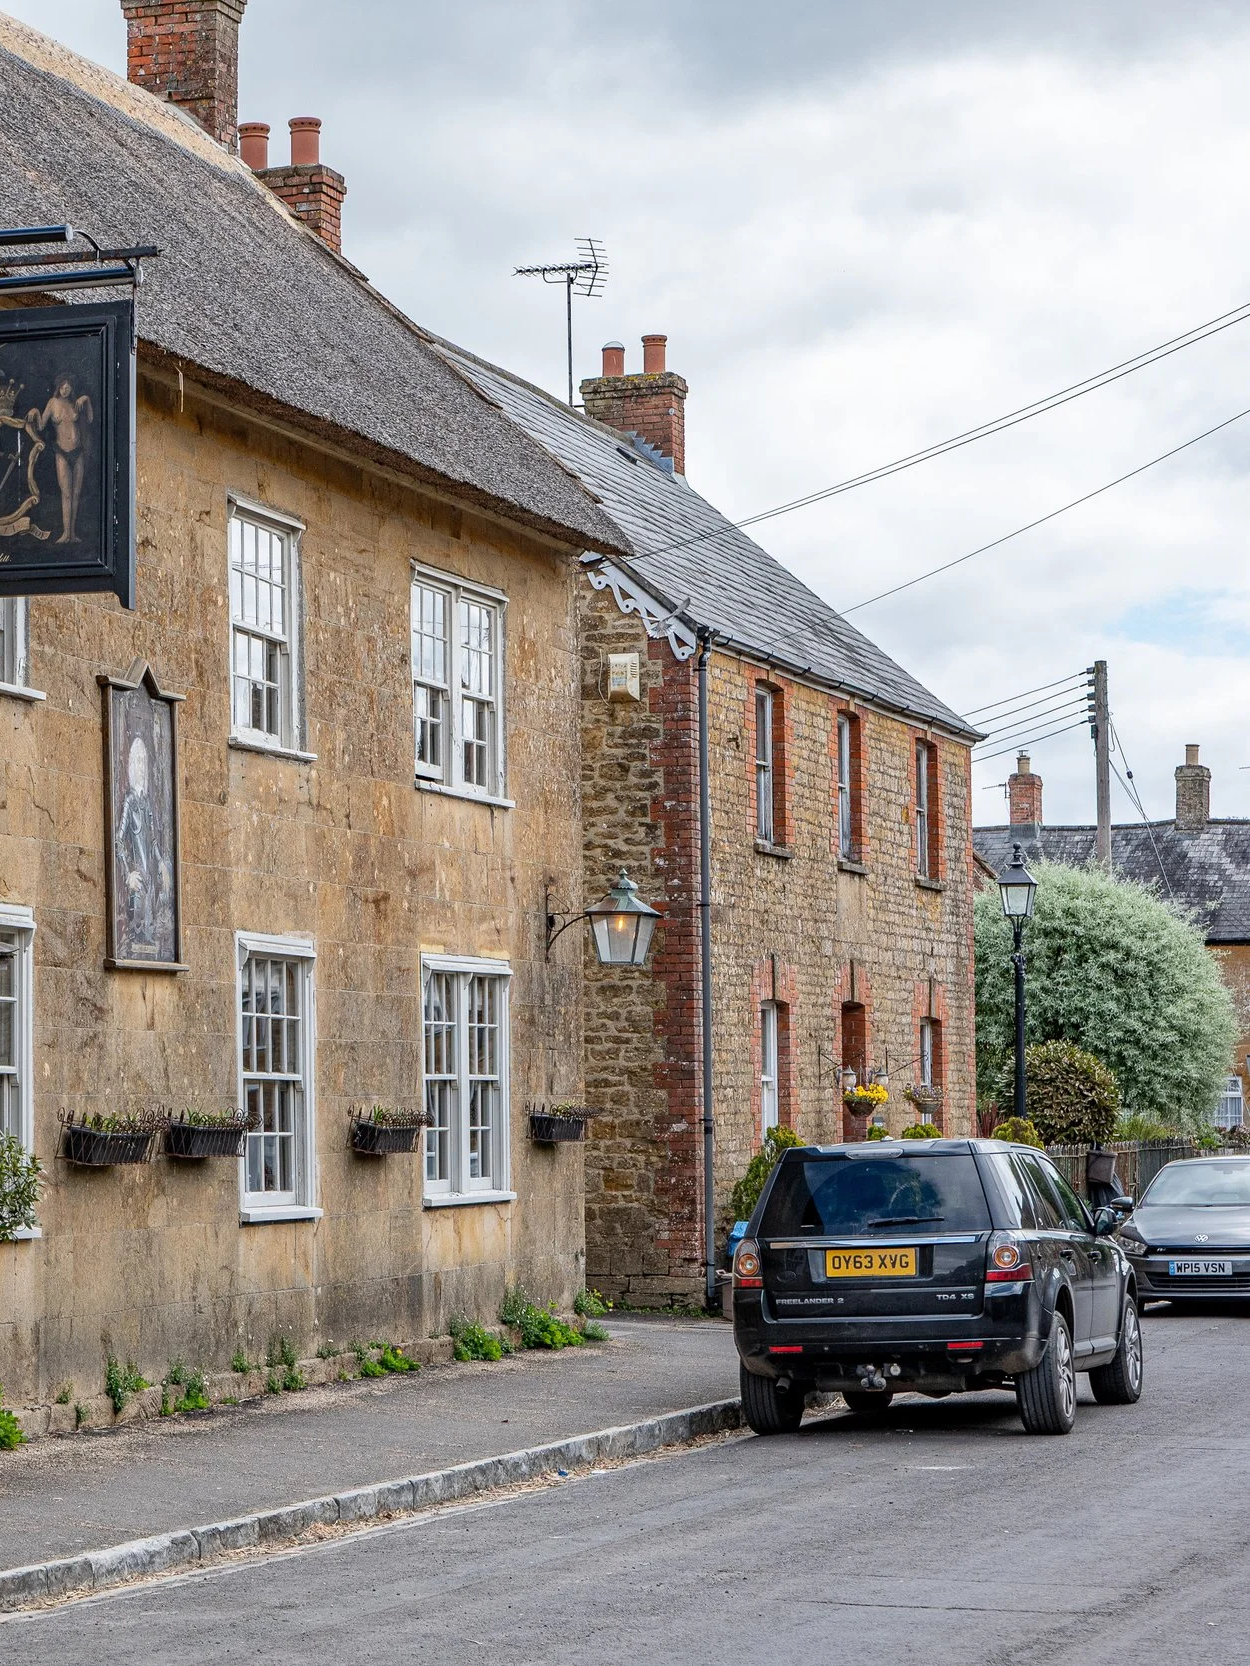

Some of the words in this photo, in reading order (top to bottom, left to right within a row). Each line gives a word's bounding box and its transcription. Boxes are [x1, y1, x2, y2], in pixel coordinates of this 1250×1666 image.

[832, 1254, 874, 1270] OY63
[878, 1254, 909, 1269] XVG
[1176, 1262, 1201, 1273] WP15
[1203, 1262, 1225, 1273] VSN
[775, 1297, 834, 1306] FREELANDER
[936, 1293, 957, 1301] TD4
